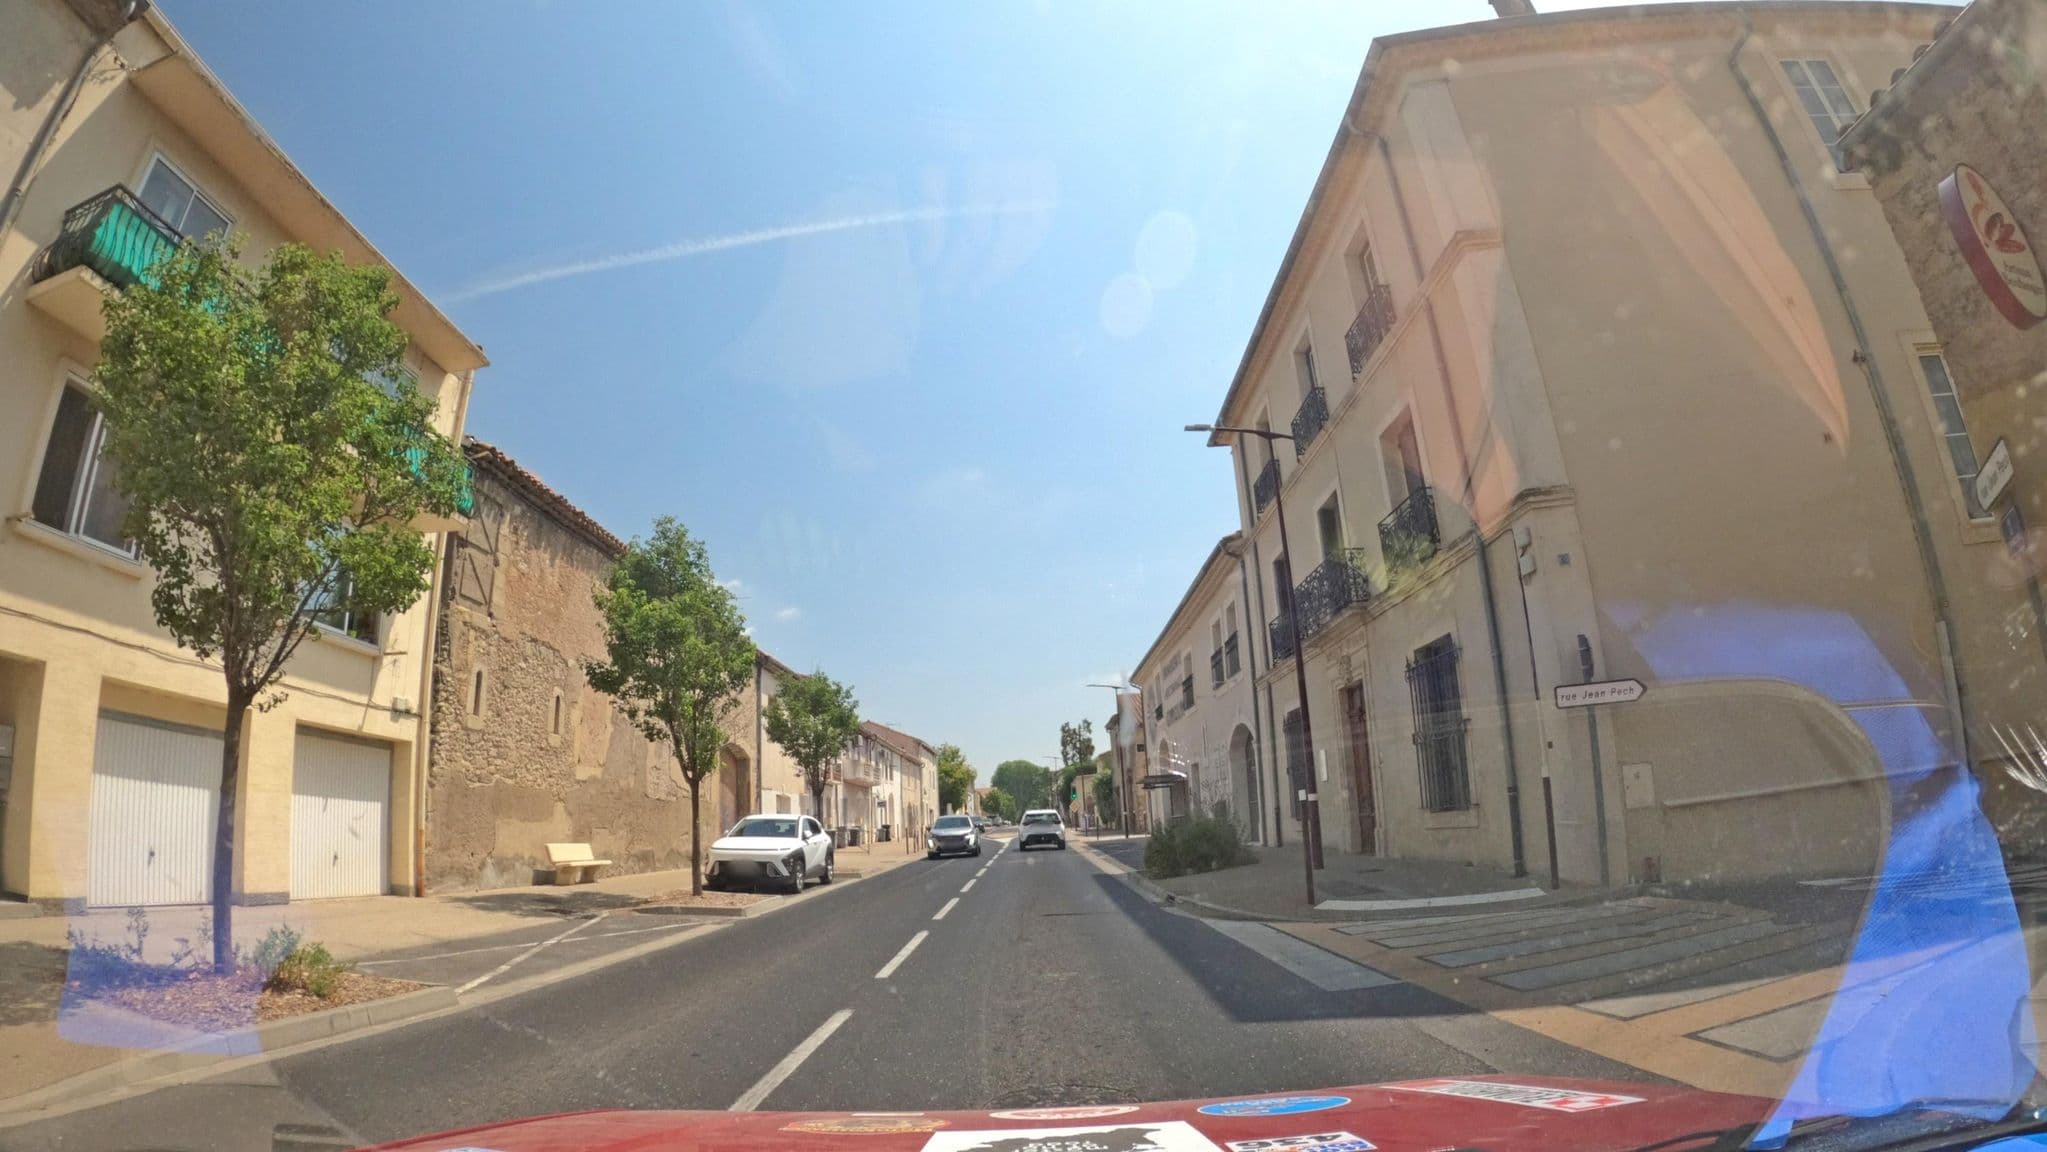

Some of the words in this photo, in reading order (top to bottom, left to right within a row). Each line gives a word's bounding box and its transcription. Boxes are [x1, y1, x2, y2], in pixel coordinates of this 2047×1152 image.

[1561, 693, 1577, 701] rue
[1582, 690, 1606, 699] Jean
[1610, 686, 1634, 697] Pech
